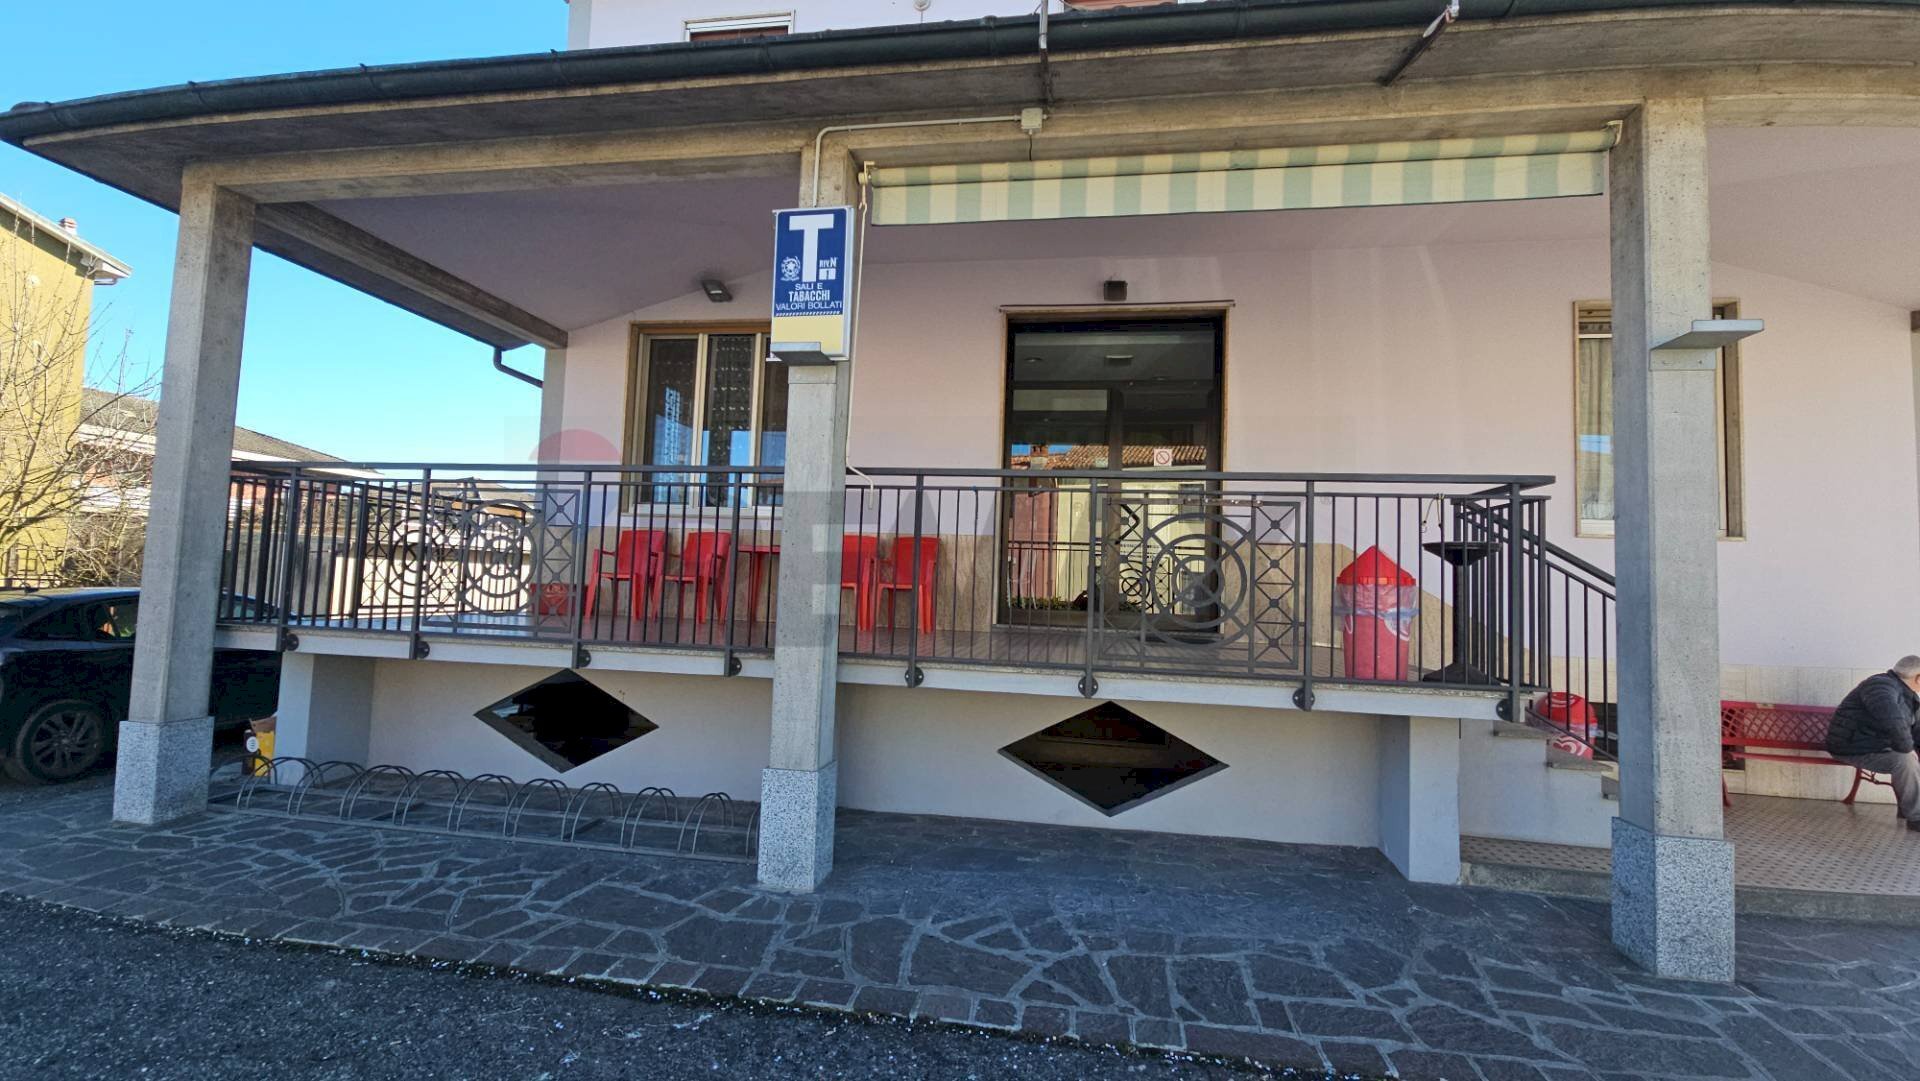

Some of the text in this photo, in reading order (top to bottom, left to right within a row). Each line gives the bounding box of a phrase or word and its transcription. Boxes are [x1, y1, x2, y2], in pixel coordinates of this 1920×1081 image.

[789, 214, 834, 282] T
[795, 282, 823, 291] SALI E
[788, 290, 830, 302] TABACCHI
[775, 301, 843, 311] VALORI BOLLATI
